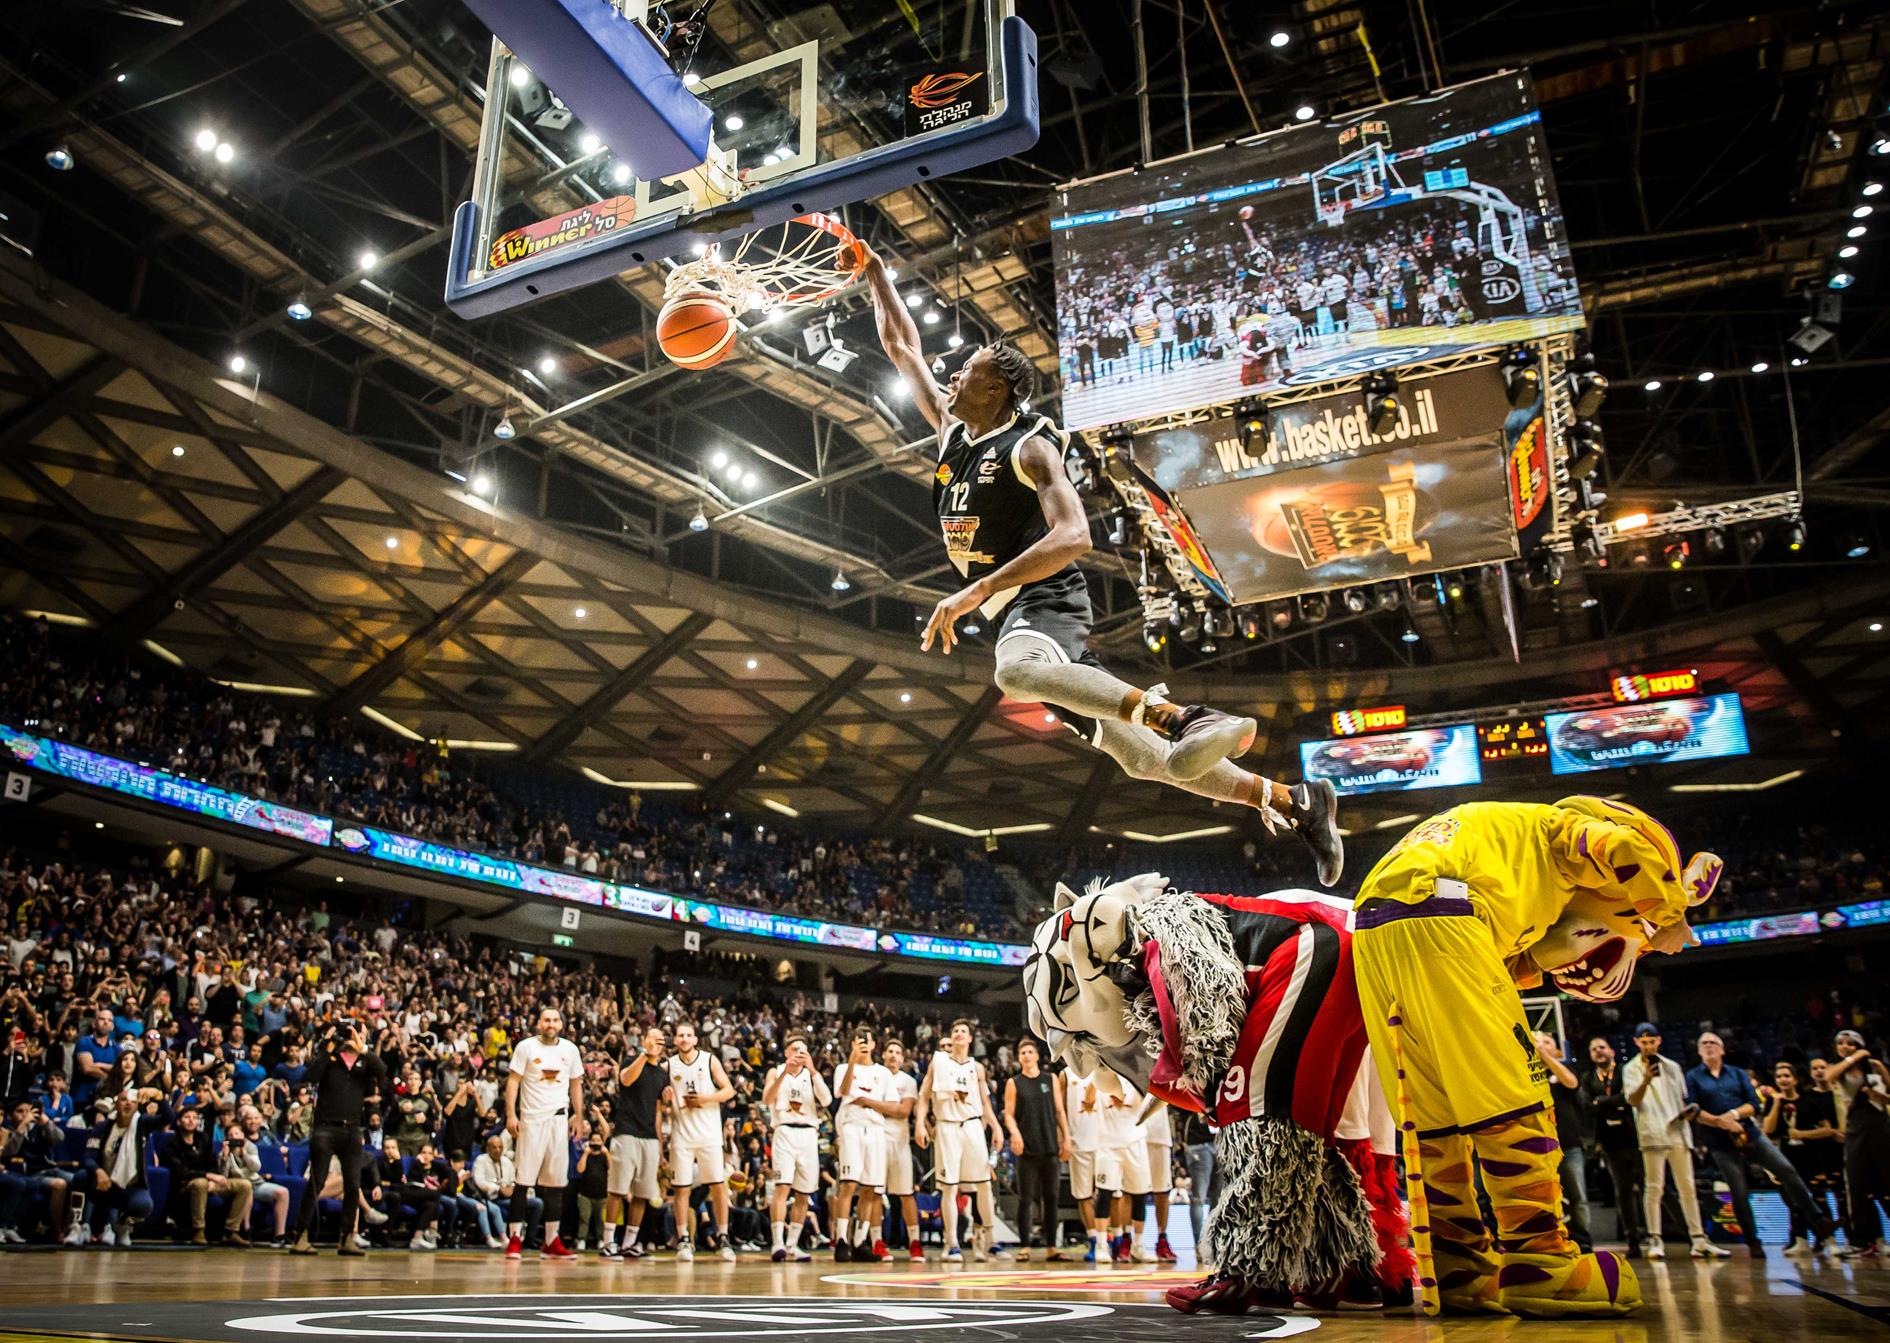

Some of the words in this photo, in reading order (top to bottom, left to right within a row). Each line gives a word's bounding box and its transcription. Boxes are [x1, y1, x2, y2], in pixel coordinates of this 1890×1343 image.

[920, 101, 973, 123] מנהלת
[923, 110, 969, 129] הליגה
[560, 210, 592, 231] ליגת
[505, 222, 593, 262] Winner
[594, 215, 617, 231] סל
[950, 481, 970, 512] 12
[12, 778, 24, 795] 3
[567, 912, 575, 924] 3
